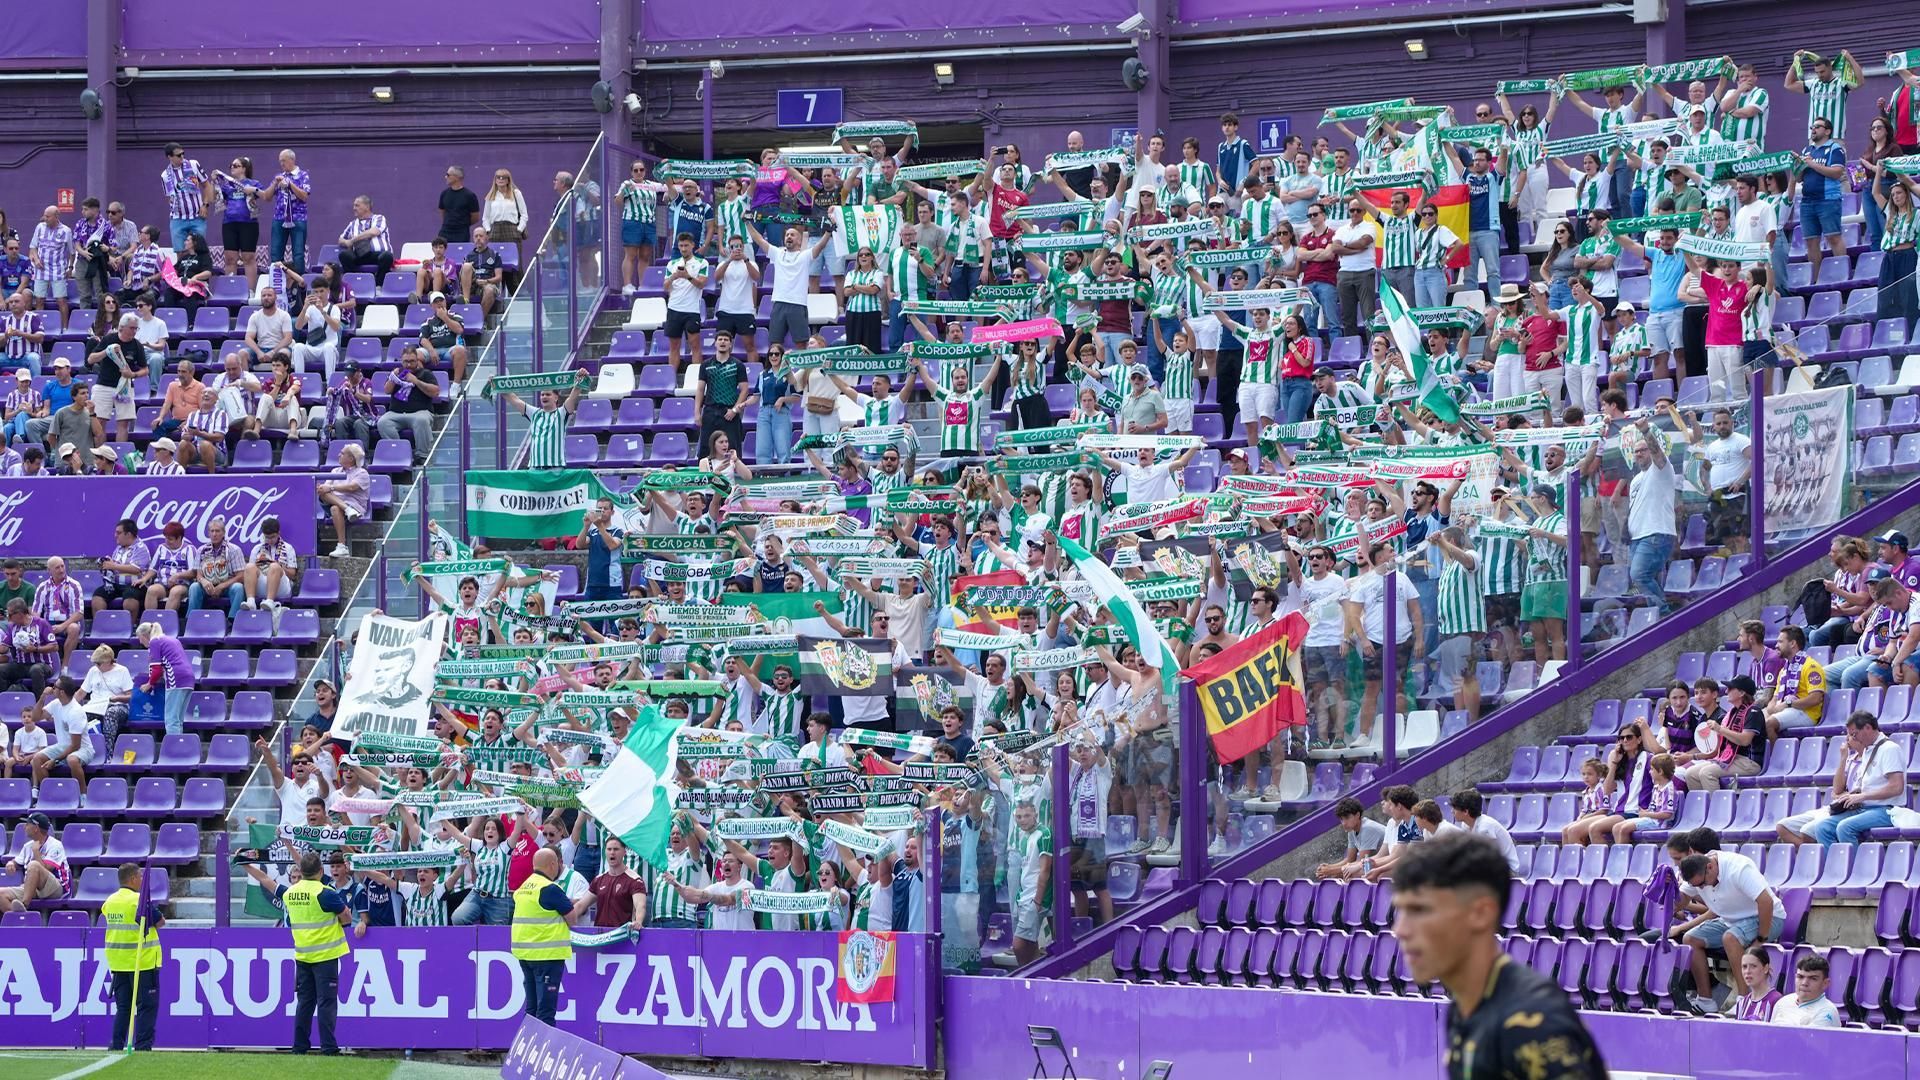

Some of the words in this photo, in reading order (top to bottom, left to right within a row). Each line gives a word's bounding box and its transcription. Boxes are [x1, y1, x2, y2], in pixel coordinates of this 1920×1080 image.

[803, 93, 818, 122] 7
[1347, 103, 1393, 117] CÓRDOBA
[1448, 126, 1493, 138] CÓRDOBA
[918, 155, 976, 165] VISITANTE
[1732, 156, 1778, 174] CÓRDOBA
[1147, 222, 1197, 237] CÓRDOBA
[1199, 220, 1212, 231] CF
[1616, 214, 1691, 230] CÓRDOBA
[1195, 249, 1250, 264] CÓRDOBA
[1009, 324, 1049, 338] CORDOBESA
[917, 342, 972, 355] CÓRDOBA
[973, 343, 987, 353] CF
[835, 356, 886, 370] CÓRDOBA
[888, 357, 903, 369] CF
[554, 374, 571, 386] CF
[1023, 428, 1076, 442] CÓRDOBA
[1017, 456, 1069, 469] CÓRDOBA
[647, 473, 709, 486] CÓRDOBA
[500, 492, 563, 511] CORDOBA
[563, 488, 584, 507] C.F.
[120, 486, 289, 546] Coca-Cola
[774, 517, 798, 529] SOMOS
[798, 517, 806, 527] DE
[806, 515, 836, 528] PRIMERA
[652, 536, 707, 549] CÓRDOBA
[816, 540, 861, 551] CÓRDOBA
[434, 562, 493, 573] CÓRDOBA
[714, 564, 730, 577] CF
[976, 588, 1046, 601] CORDOBA
[686, 628, 716, 639] ESTAMOS
[717, 627, 751, 638] VOLVIENDO
[1034, 651, 1078, 667] CÓRDOBA
[441, 664, 473, 675] HEREDEROS
[456, 691, 509, 704] CÓRDOBA
[564, 694, 612, 704] CORDOBA
[361, 734, 394, 746] HEREDEROS
[905, 766, 922, 777] BANDA
[923, 766, 933, 777] DEL
[762, 776, 789, 788] BANDA
[789, 774, 805, 785] DEL
[679, 792, 706, 803] CALIFATO
[706, 792, 752, 804] BLANQUIVERDE
[821, 797, 845, 808] BANDA
[846, 796, 860, 807] DEL
[879, 792, 920, 806] DIECIOCHO
[351, 830, 368, 841] CF
[288, 892, 311, 901] EULEN
[170, 947, 449, 1018] RUAL
